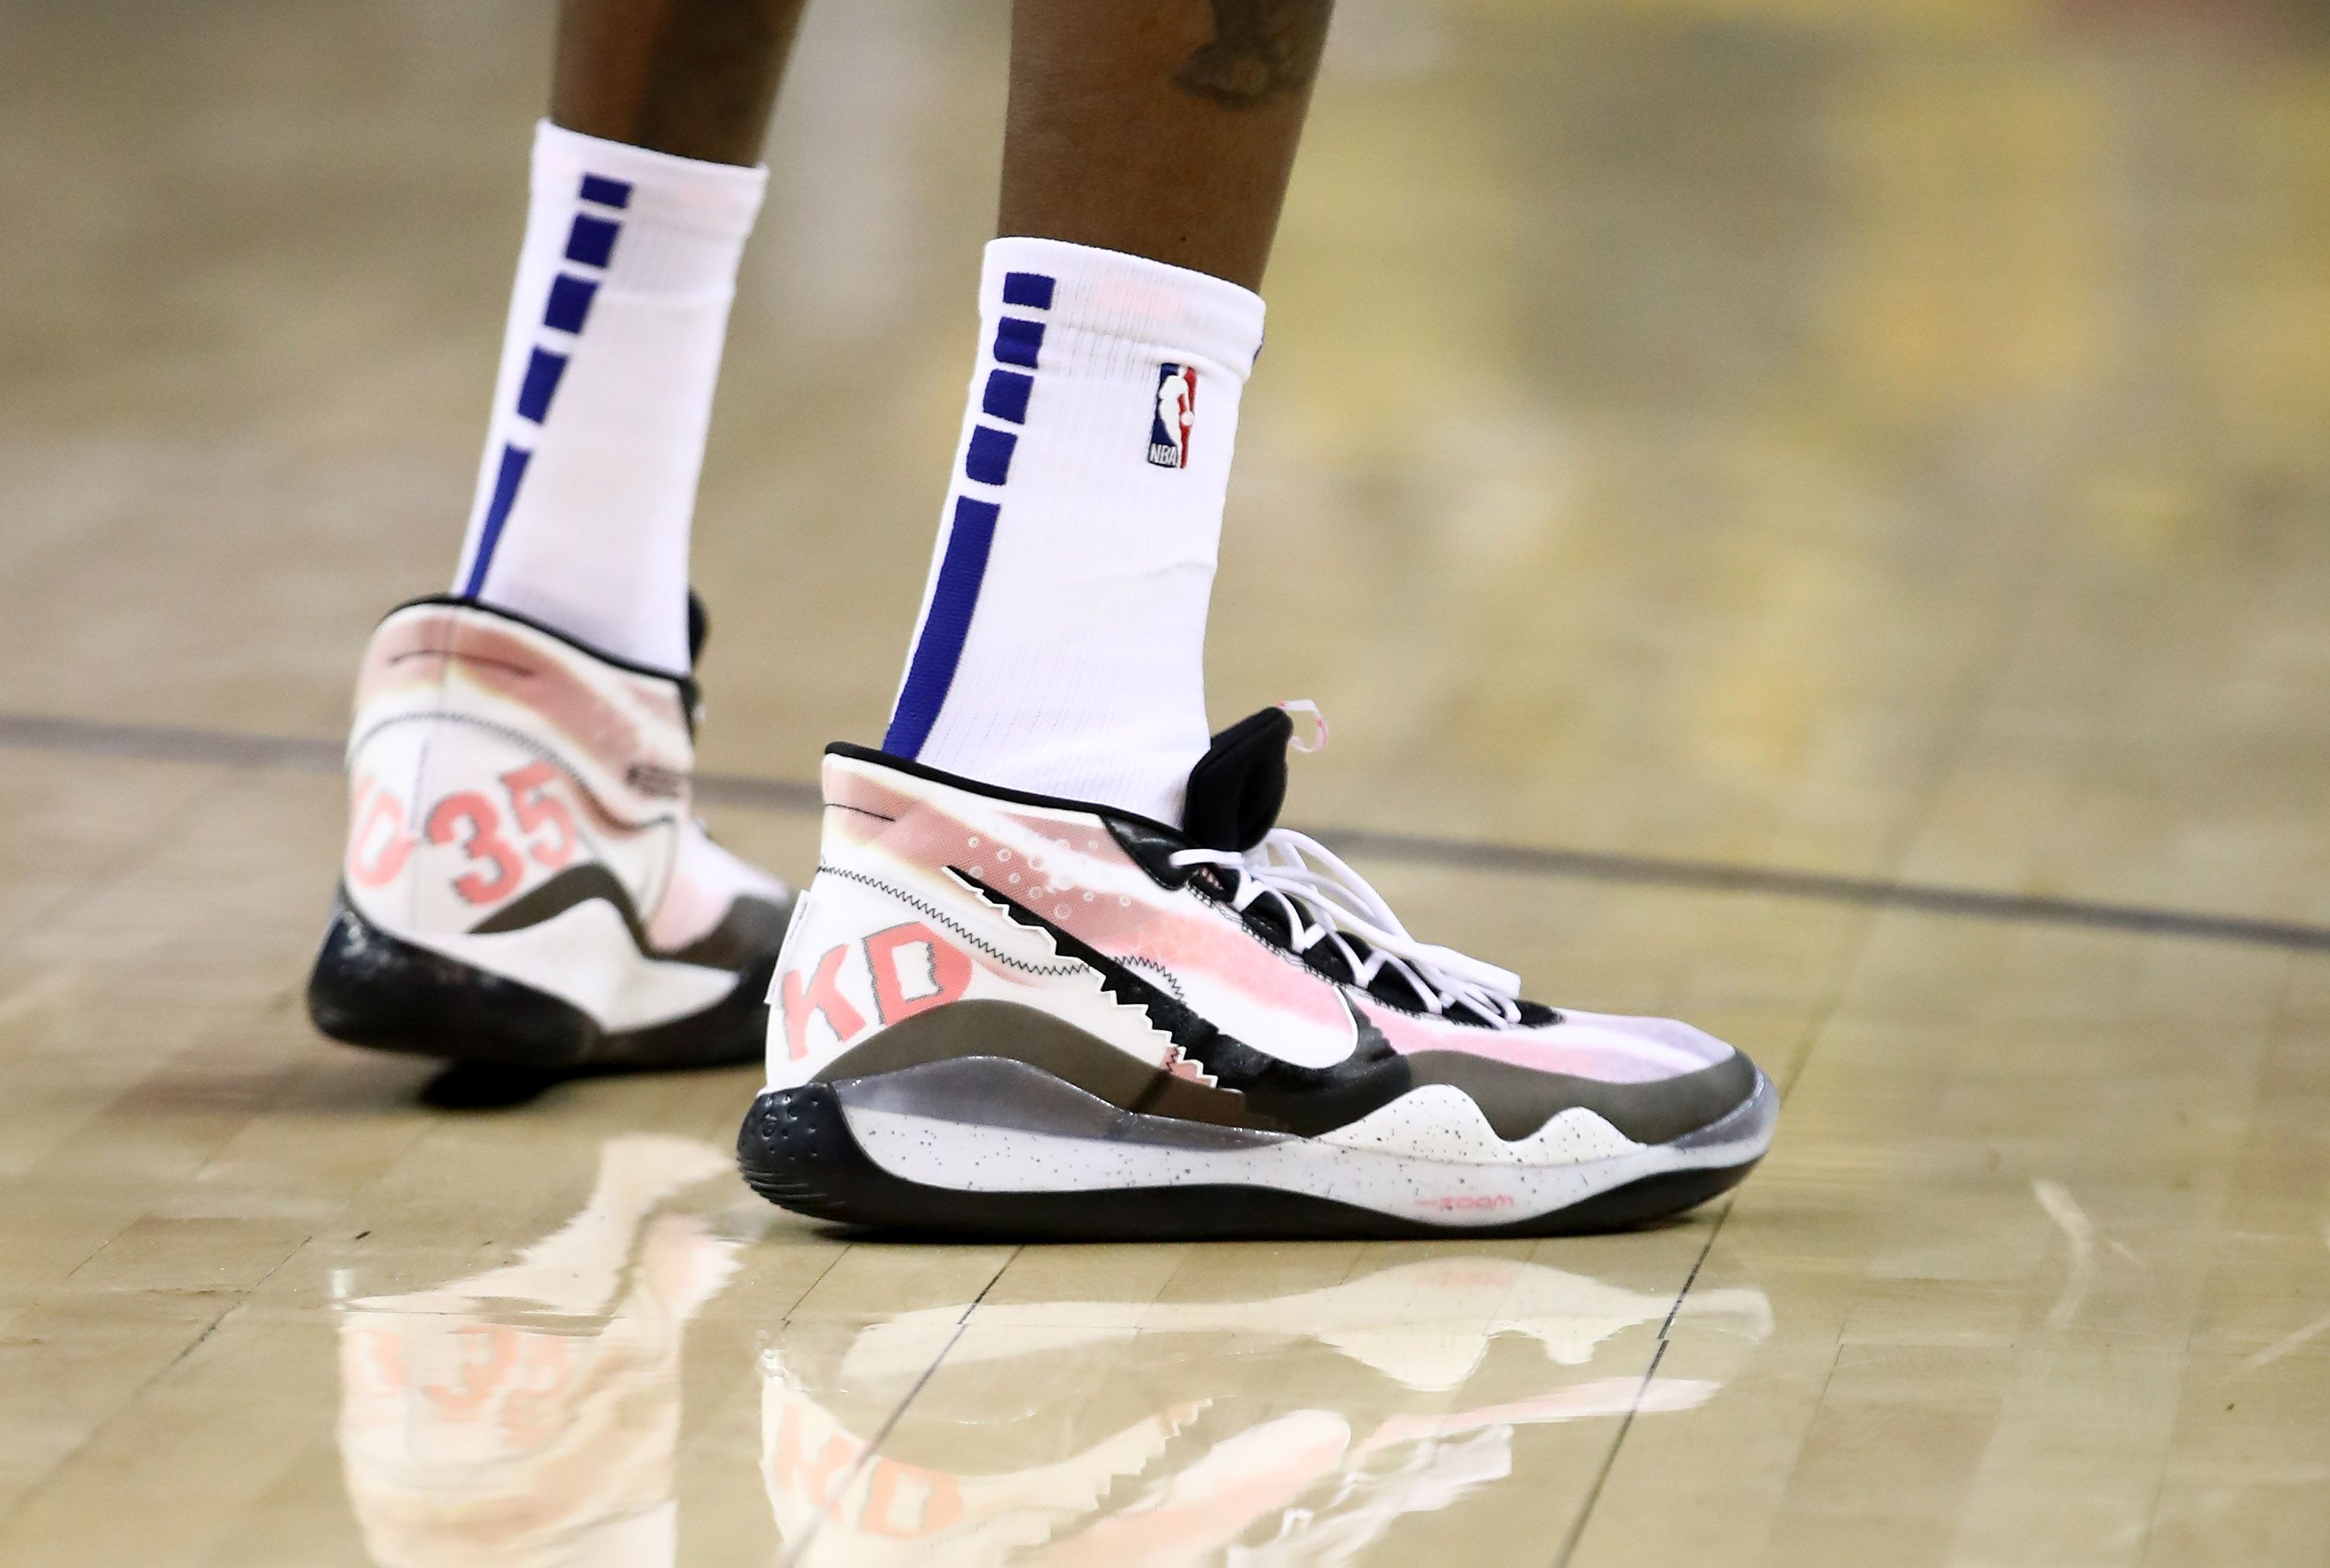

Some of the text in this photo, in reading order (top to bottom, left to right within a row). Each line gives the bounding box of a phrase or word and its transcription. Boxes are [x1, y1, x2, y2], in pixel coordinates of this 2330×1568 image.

[1148, 443, 1178, 466] NBA
[423, 760, 576, 907] 35
[781, 921, 973, 1062] KD
